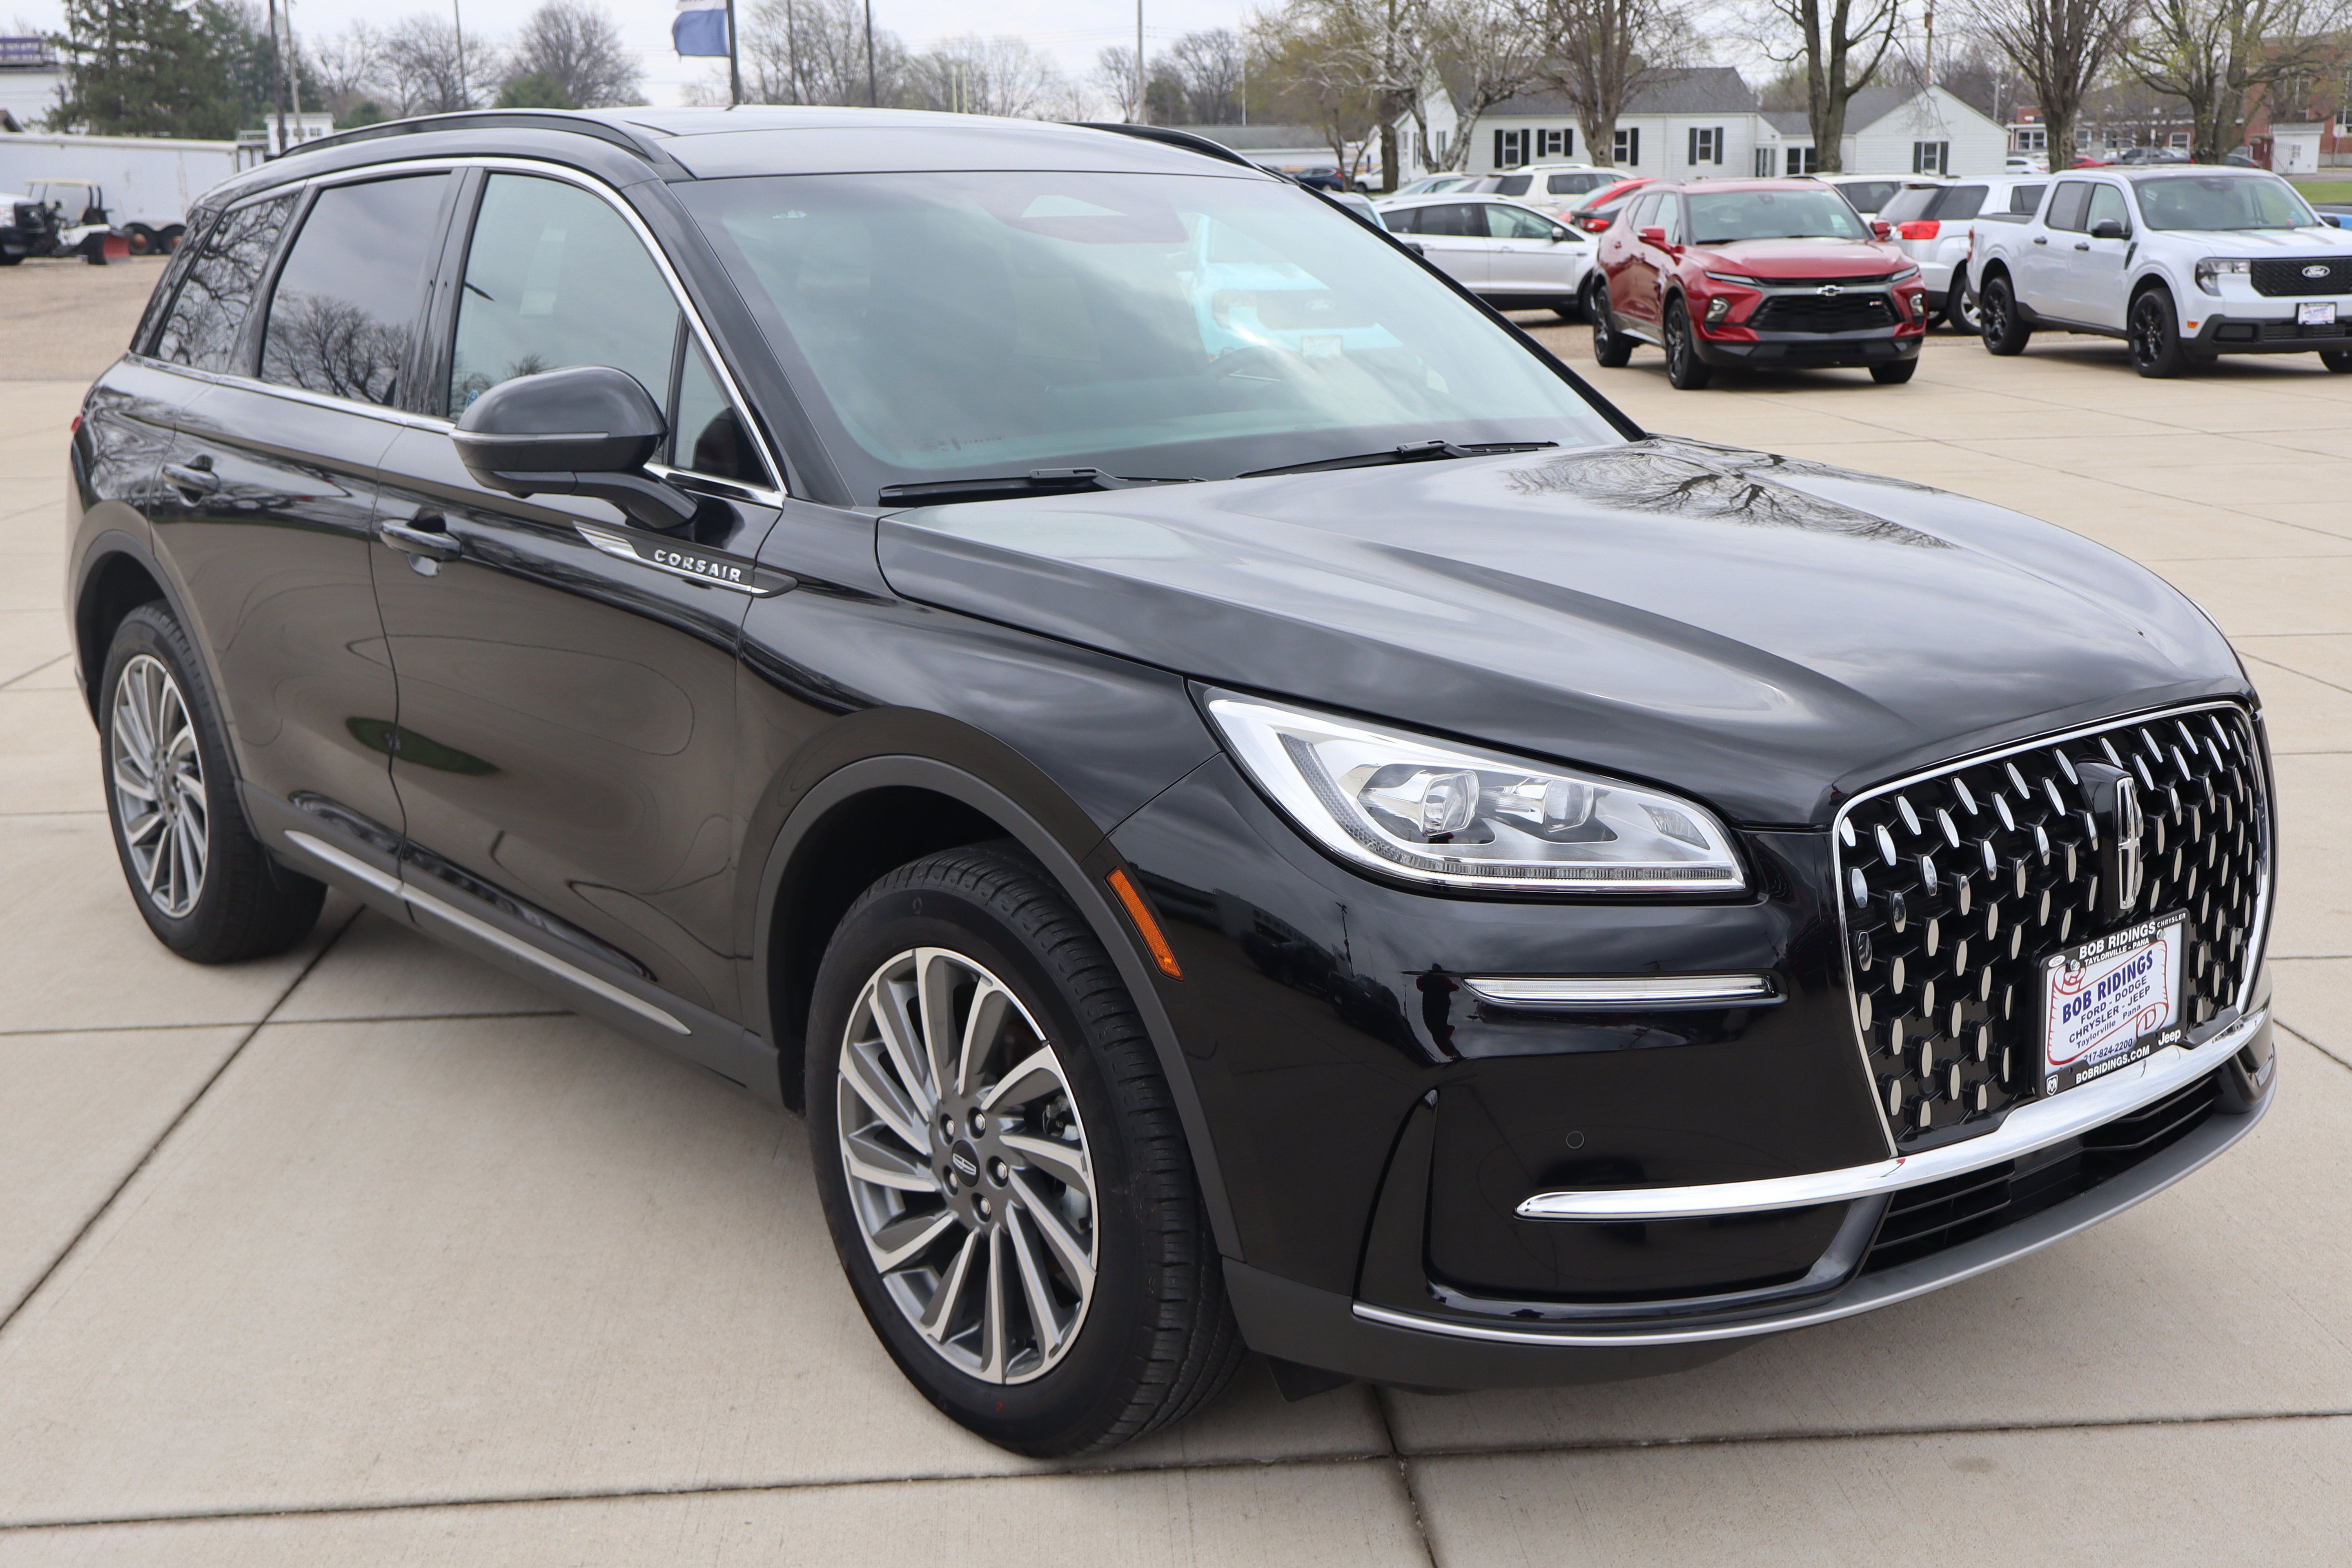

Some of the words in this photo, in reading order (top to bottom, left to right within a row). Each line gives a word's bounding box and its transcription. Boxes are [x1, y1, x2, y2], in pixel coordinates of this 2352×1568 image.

[654, 549, 742, 582] CORSAIR
[2157, 913, 2186, 928] CHRYSLER
[2079, 939, 2104, 960] BOB
[2108, 921, 2156, 949] RIDINGS
[2084, 945, 2127, 966] TAYLORVILLE
[2133, 937, 2149, 949] PANA
[2063, 990, 2091, 1024] BOB
[2098, 950, 2153, 1002] RIDINGS
[2081, 1002, 2106, 1025] FORD
[2115, 975, 2147, 1002] DODGE
[2069, 1005, 2119, 1043] CHRYSLER
[2128, 985, 2150, 1006] JEEP
[2076, 1020, 2116, 1049] Taylorville
[2123, 1004, 2141, 1020] Pana
[2084, 1038, 2133, 1062] 217-824-2200
[2158, 1029, 2181, 1046] Jeep
[2076, 1045, 2150, 1084] BOBRIDINGS.COM
